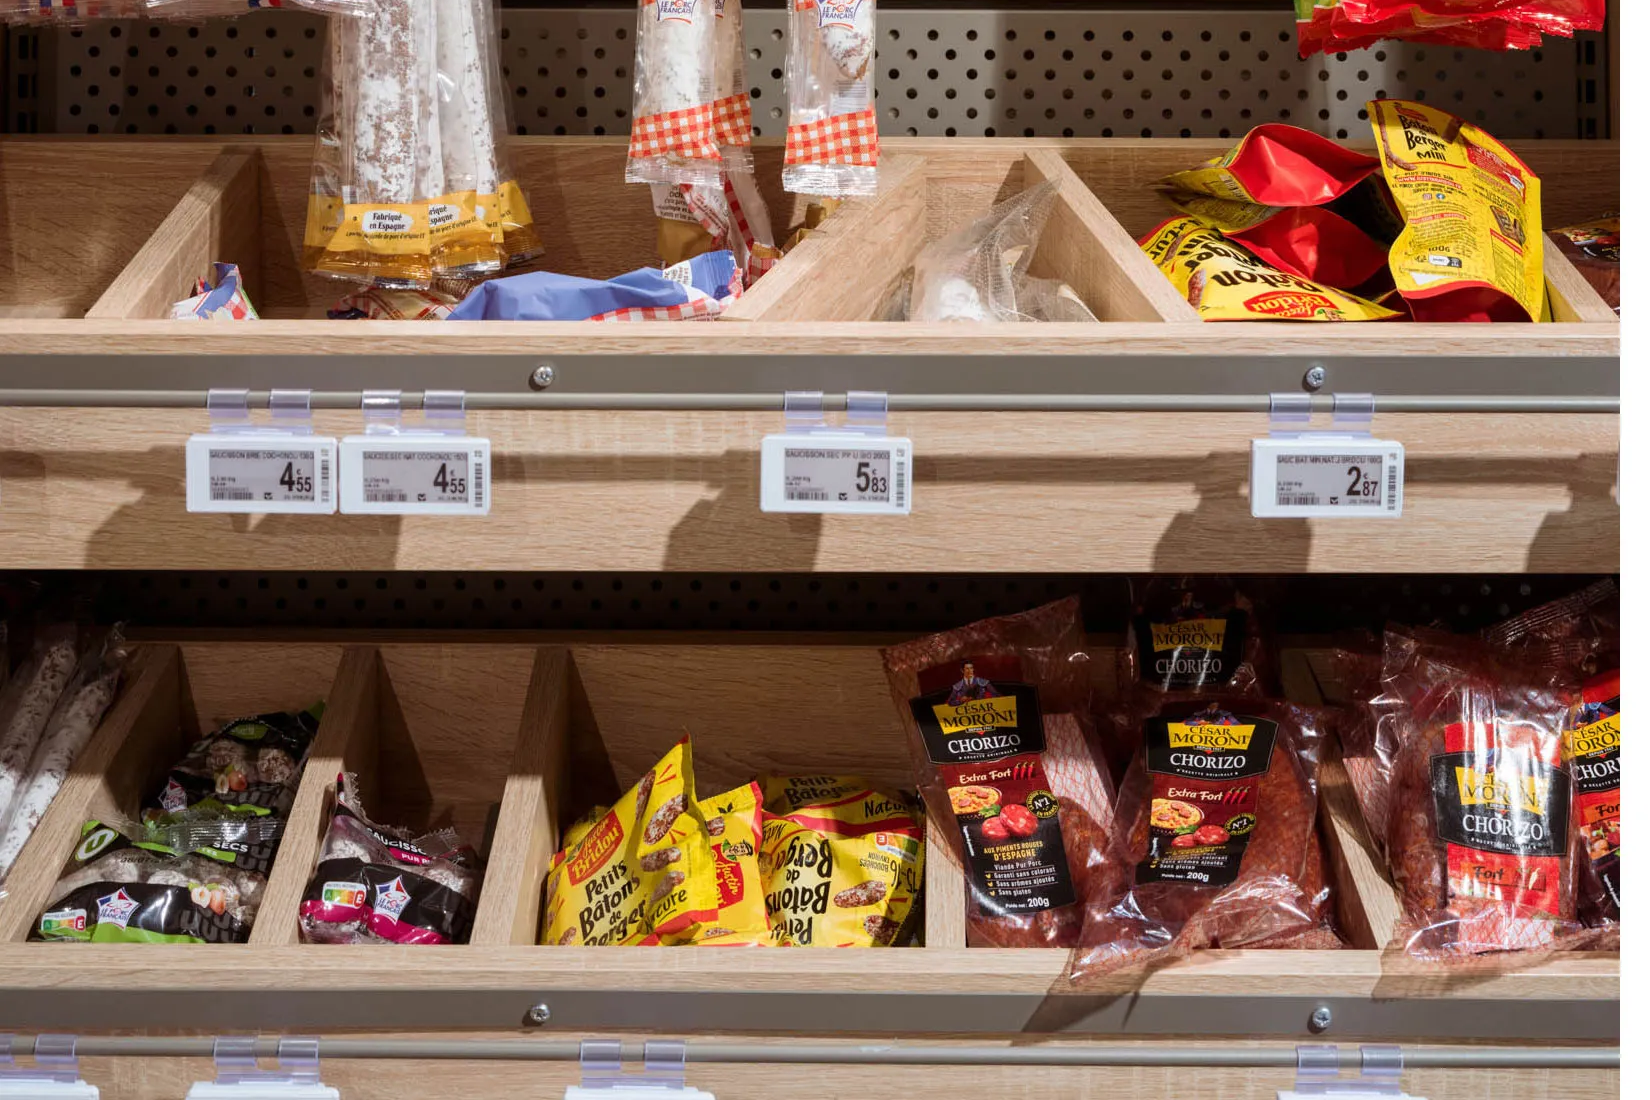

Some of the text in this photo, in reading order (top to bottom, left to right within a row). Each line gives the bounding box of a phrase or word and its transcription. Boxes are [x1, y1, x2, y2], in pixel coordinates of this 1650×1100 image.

[1404, 130, 1447, 151] Berger
[1416, 150, 1447, 162] Mini
[372, 212, 403, 222] Fabriqué
[430, 213, 454, 226] spagne
[378, 222, 406, 231] Espagne
[1146, 217, 1204, 262] Natur
[1155, 632, 1222, 646] MORONI
[1155, 658, 1222, 674] CHORIZO
[955, 701, 996, 716] CÉSAR
[943, 709, 1015, 728] MORONI
[1189, 725, 1231, 736] CÉSAR
[947, 734, 1021, 754] CHORIZO
[1173, 733, 1249, 747] MORONI
[1169, 753, 1246, 769] CHORIZO
[959, 768, 1012, 784] Extra Fort
[1573, 757, 1620, 781] CHOR
[1167, 787, 1223, 801] Extra Fort
[864, 800, 908, 818] Natur
[1595, 803, 1620, 817] For
[212, 840, 249, 853] SECS
[571, 824, 620, 879] Bridou
[996, 844, 1021, 853] PIMENTS
[401, 852, 420, 862] PUR
[993, 850, 1036, 862] D'ESPAGNE
[994, 863, 1014, 871] Viande
[1472, 866, 1504, 880] Fort
[584, 859, 628, 904] Petits
[785, 869, 801, 884] de
[1186, 871, 1210, 883] 200g
[650, 888, 688, 921] ture
[765, 881, 831, 914] Bâtons
[1027, 897, 1050, 908] 200g
[579, 870, 641, 941] Bâtons
[609, 910, 622, 925] de
